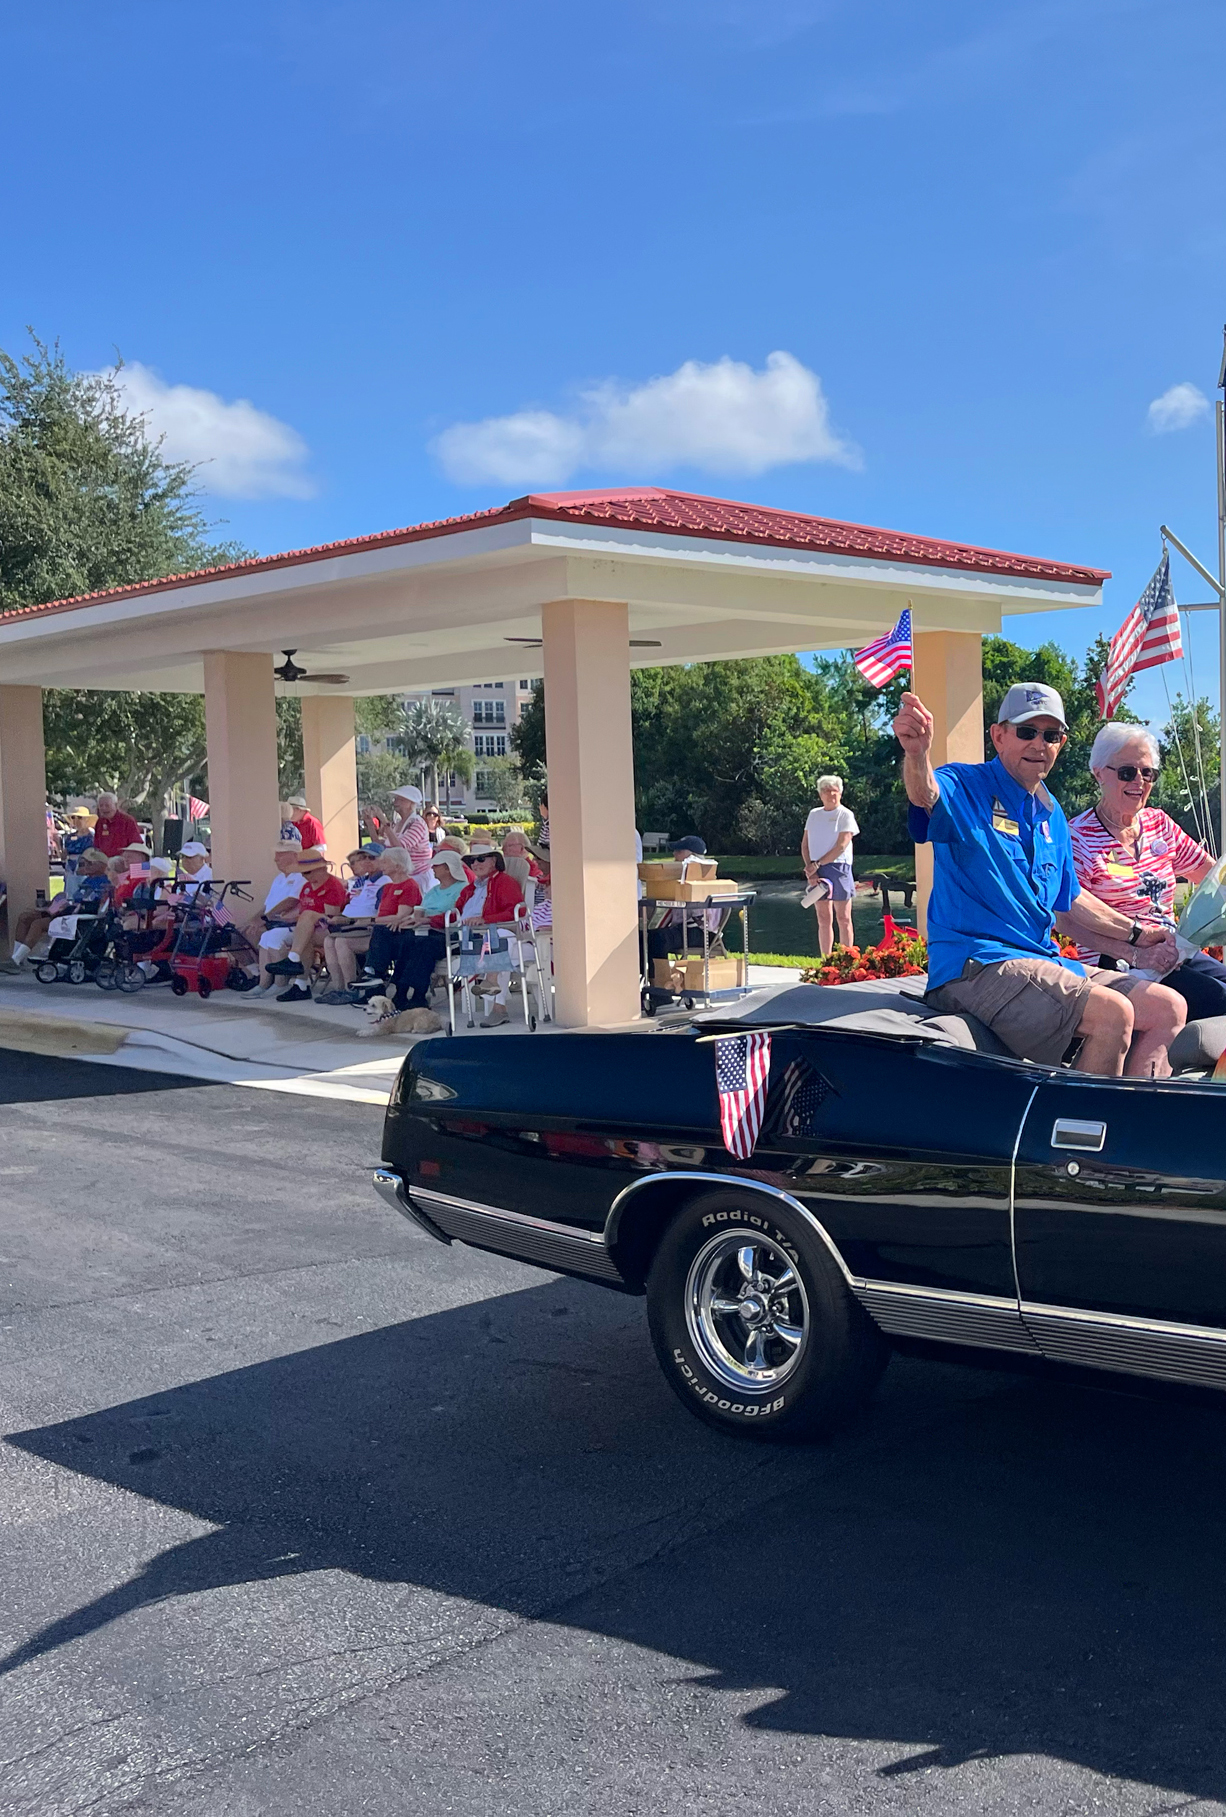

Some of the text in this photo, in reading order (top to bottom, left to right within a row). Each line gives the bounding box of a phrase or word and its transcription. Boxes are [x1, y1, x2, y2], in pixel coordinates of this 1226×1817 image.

[702, 1210, 800, 1264] Radial T/A
[673, 1348, 785, 1416] BFGoodrich
